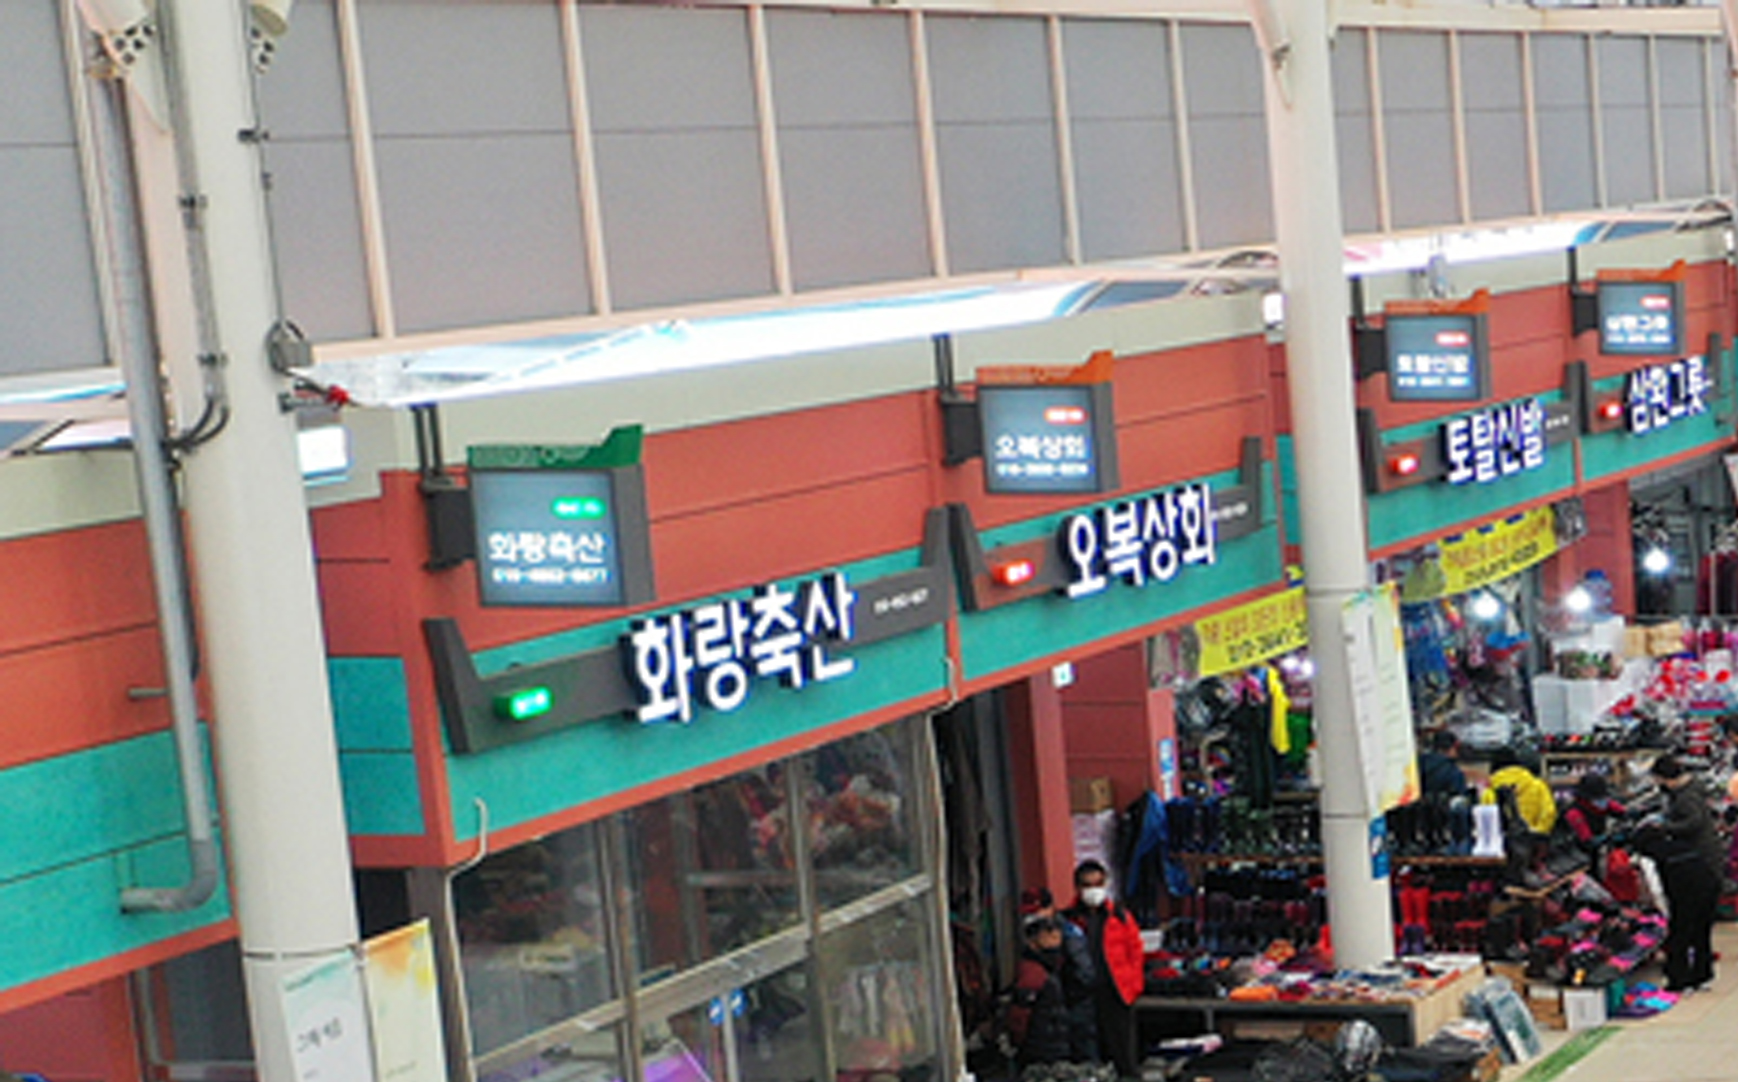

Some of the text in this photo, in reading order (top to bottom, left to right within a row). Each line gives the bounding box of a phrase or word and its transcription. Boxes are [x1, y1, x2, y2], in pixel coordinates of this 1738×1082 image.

[1448, 398, 1545, 482] 토탈신발
[488, 532, 605, 562] 화랑축산
[1068, 483, 1215, 598] 오복상회
[632, 571, 855, 723] 화랑축산
